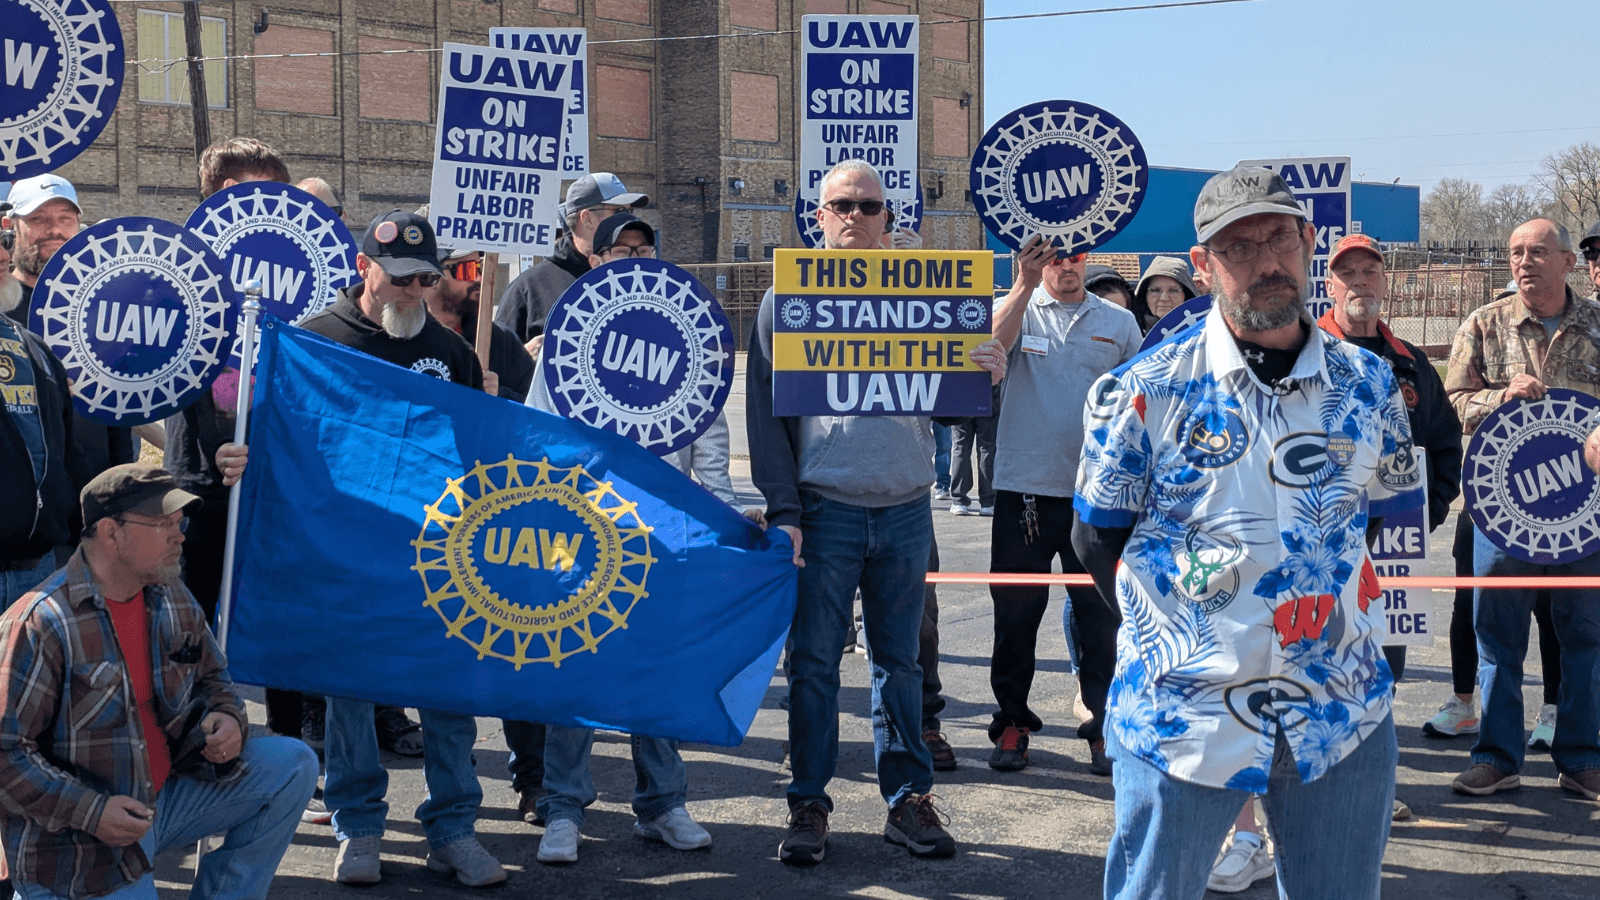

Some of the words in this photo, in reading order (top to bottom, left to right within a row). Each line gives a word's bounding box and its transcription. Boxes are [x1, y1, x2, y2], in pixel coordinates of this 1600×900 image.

[50, 6, 77, 53] IMPLEMENT
[808, 21, 915, 49] UAW
[495, 33, 583, 56] UAW
[63, 57, 78, 98] WORKERS
[449, 51, 567, 92] UAW
[840, 58, 881, 85] ON
[55, 99, 65, 111] OF
[481, 97, 526, 128] ON
[810, 88, 910, 115] STRIKE
[19, 112, 54, 134] AMERICA
[822, 124, 899, 144] UNFAIR
[1034, 131, 1081, 140] AGRICULTURAL
[444, 126, 557, 164] STRIKE
[825, 147, 894, 166] LABOR
[1020, 138, 1033, 149] AND
[1082, 136, 1110, 161] IMPLEMENT
[1002, 148, 1020, 179] AEROSPACE
[1107, 161, 1115, 189] WORKERS
[1263, 162, 1346, 189] AW
[455, 167, 541, 195] UNFAIR
[1022, 164, 1091, 204] UAW
[1107, 190, 1113, 199] OF
[457, 192, 534, 219] LABOR
[1088, 199, 1109, 221] AMERICA
[1294, 198, 1314, 222] N
[244, 216, 260, 226] AND
[262, 217, 309, 240] AGRICULTURAL
[436, 215, 550, 245] PRACTICE
[1019, 215, 1040, 231] UNITED
[214, 223, 242, 251] AEROSPACE
[108, 258, 125, 269] AND
[127, 256, 179, 276] AGRICULTURAL
[307, 239, 327, 276] IMPLEMENT
[76, 267, 106, 301] AEROSPACE
[230, 253, 307, 305] UAW
[796, 258, 867, 288] THIS
[881, 258, 973, 289] HOME
[178, 274, 202, 314] IMPLEMENT
[315, 278, 327, 311] WORKERS
[622, 294, 638, 303] AND
[640, 294, 685, 320] AGRICULTURAL
[95, 300, 179, 347] UAW
[589, 299, 620, 328] AEROSPACE
[789, 309, 803, 317] UAW
[815, 299, 952, 329] STANDS
[965, 310, 979, 318] UAW
[189, 315, 202, 351] WORKERS
[684, 319, 702, 358] IMPLEMENT
[80, 354, 100, 378] UNITED
[183, 352, 191, 362] OF
[602, 330, 682, 386] UAW
[803, 340, 891, 367] WITH
[899, 340, 964, 367] THE
[153, 362, 182, 385] AMERICA
[688, 360, 702, 394] WORKERS
[584, 378, 602, 403] UNITED
[681, 394, 689, 404] OF
[826, 373, 942, 412] UAW
[652, 402, 680, 421] AMERICA
[1505, 435, 1517, 448] AND
[1518, 420, 1563, 437] AGRICULTURAL
[1564, 422, 1588, 437] IMPLEM
[1202, 433, 1245, 466] BREWERS
[1327, 444, 1356, 452] NURSES
[1494, 449, 1506, 484] AEROSPACE
[1514, 449, 1583, 504] UAW
[481, 501, 493, 512] OF
[495, 489, 540, 506] AMERICA
[544, 487, 580, 505] UNITED
[1521, 520, 1544, 531] UNITED
[483, 526, 584, 572] UAW
[1371, 525, 1421, 554] IKE
[453, 547, 480, 598] IMPLEMENT
[580, 557, 615, 608] AEROSPACE
[480, 595, 556, 626] AGRICULTURAL
[559, 605, 581, 621] AND
